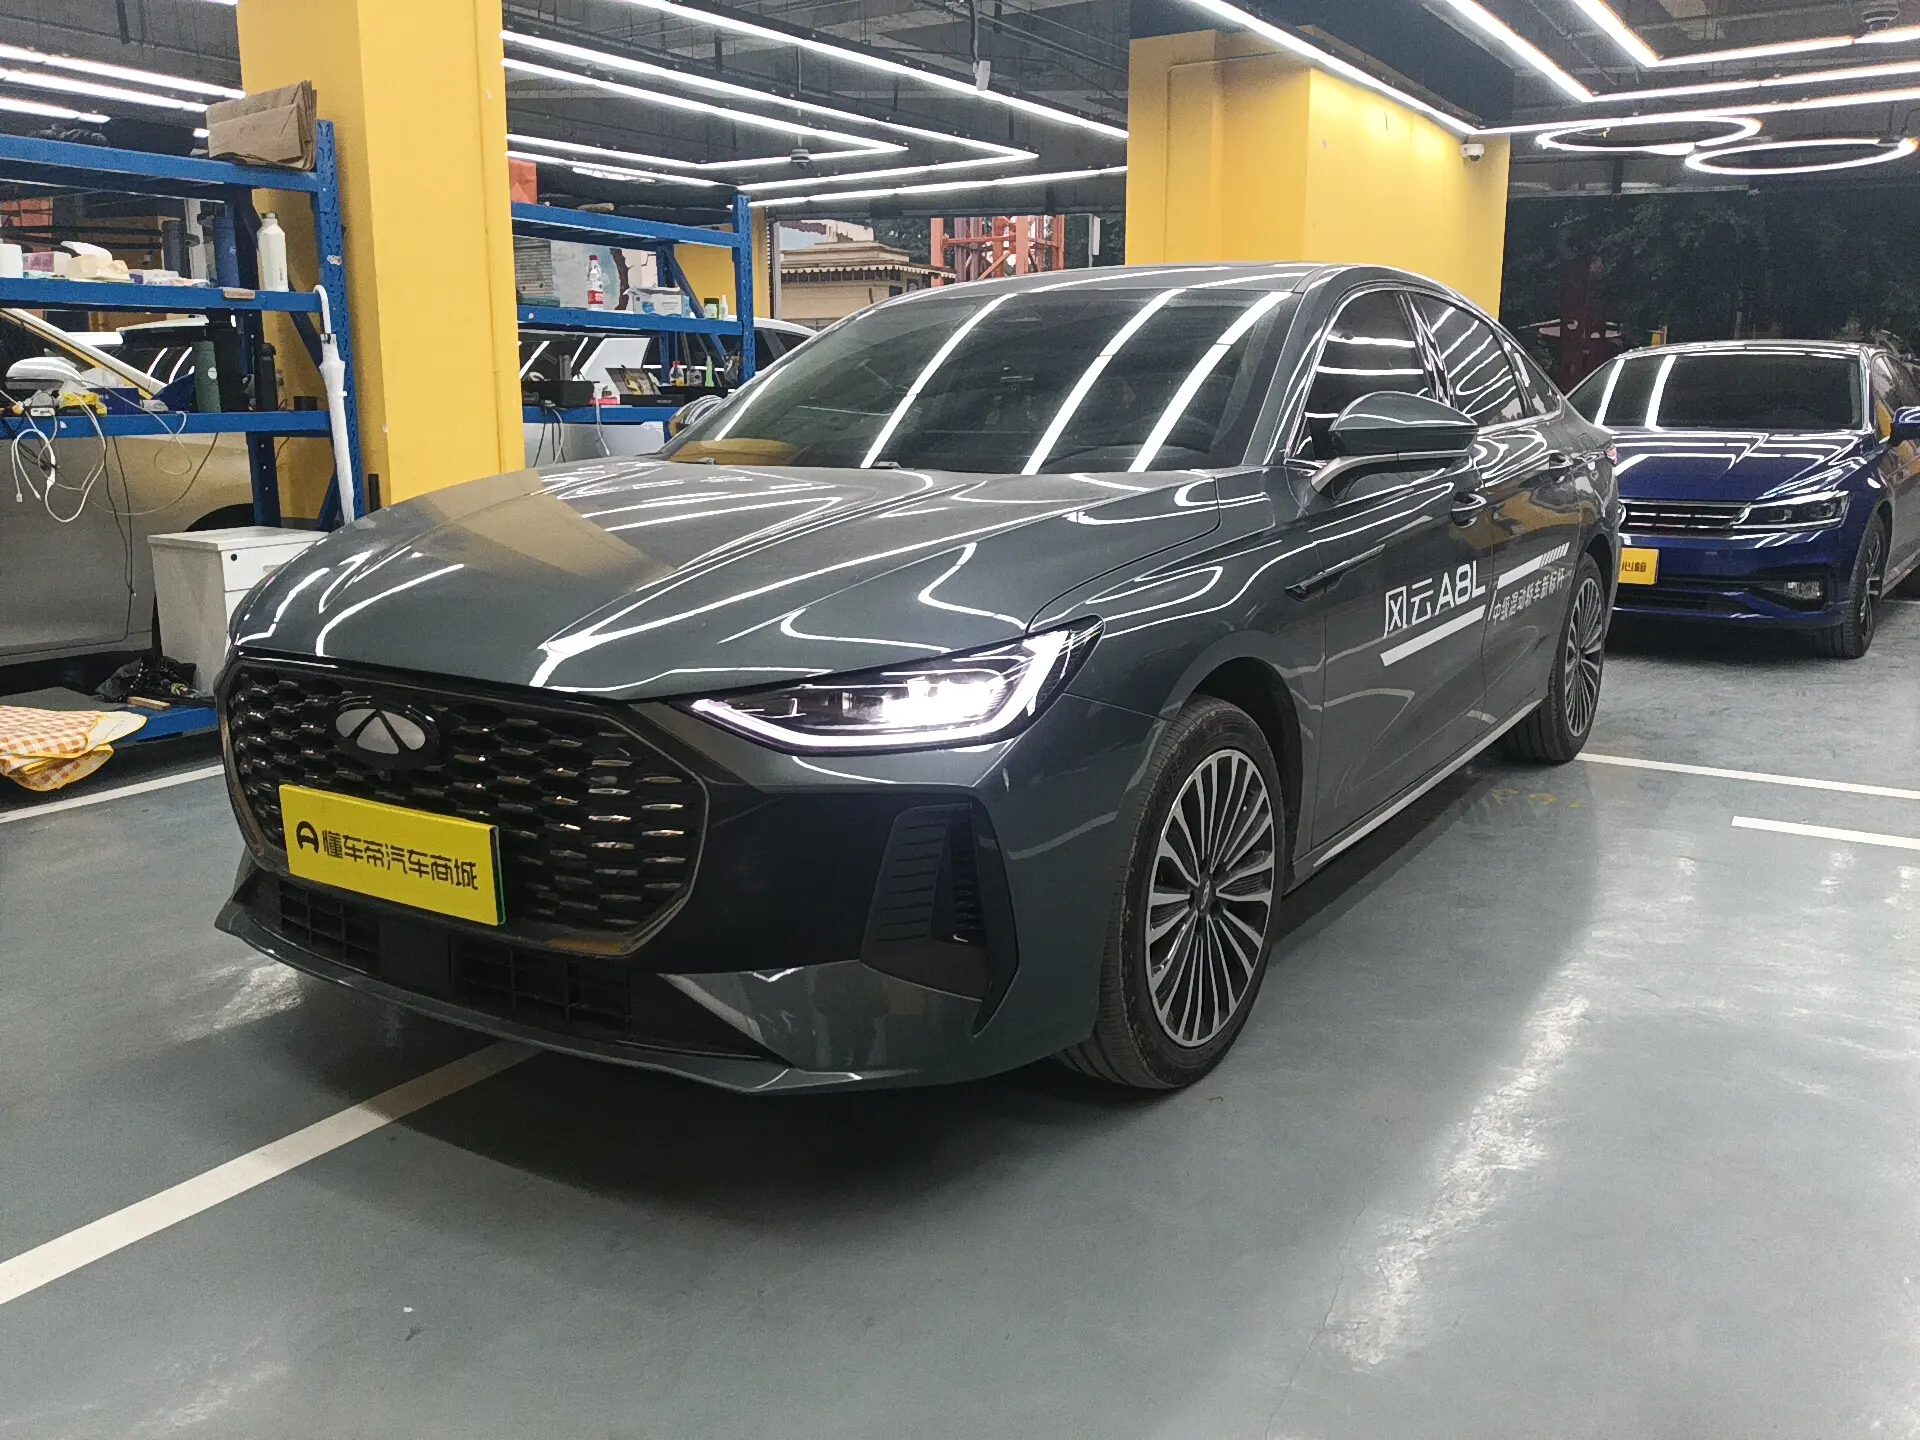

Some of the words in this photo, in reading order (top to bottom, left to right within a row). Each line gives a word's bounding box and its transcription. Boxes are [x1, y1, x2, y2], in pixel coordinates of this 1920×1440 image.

[1383, 560, 1486, 639] 风云A8L
[322, 829, 479, 891] 懂车帝汽车商城
